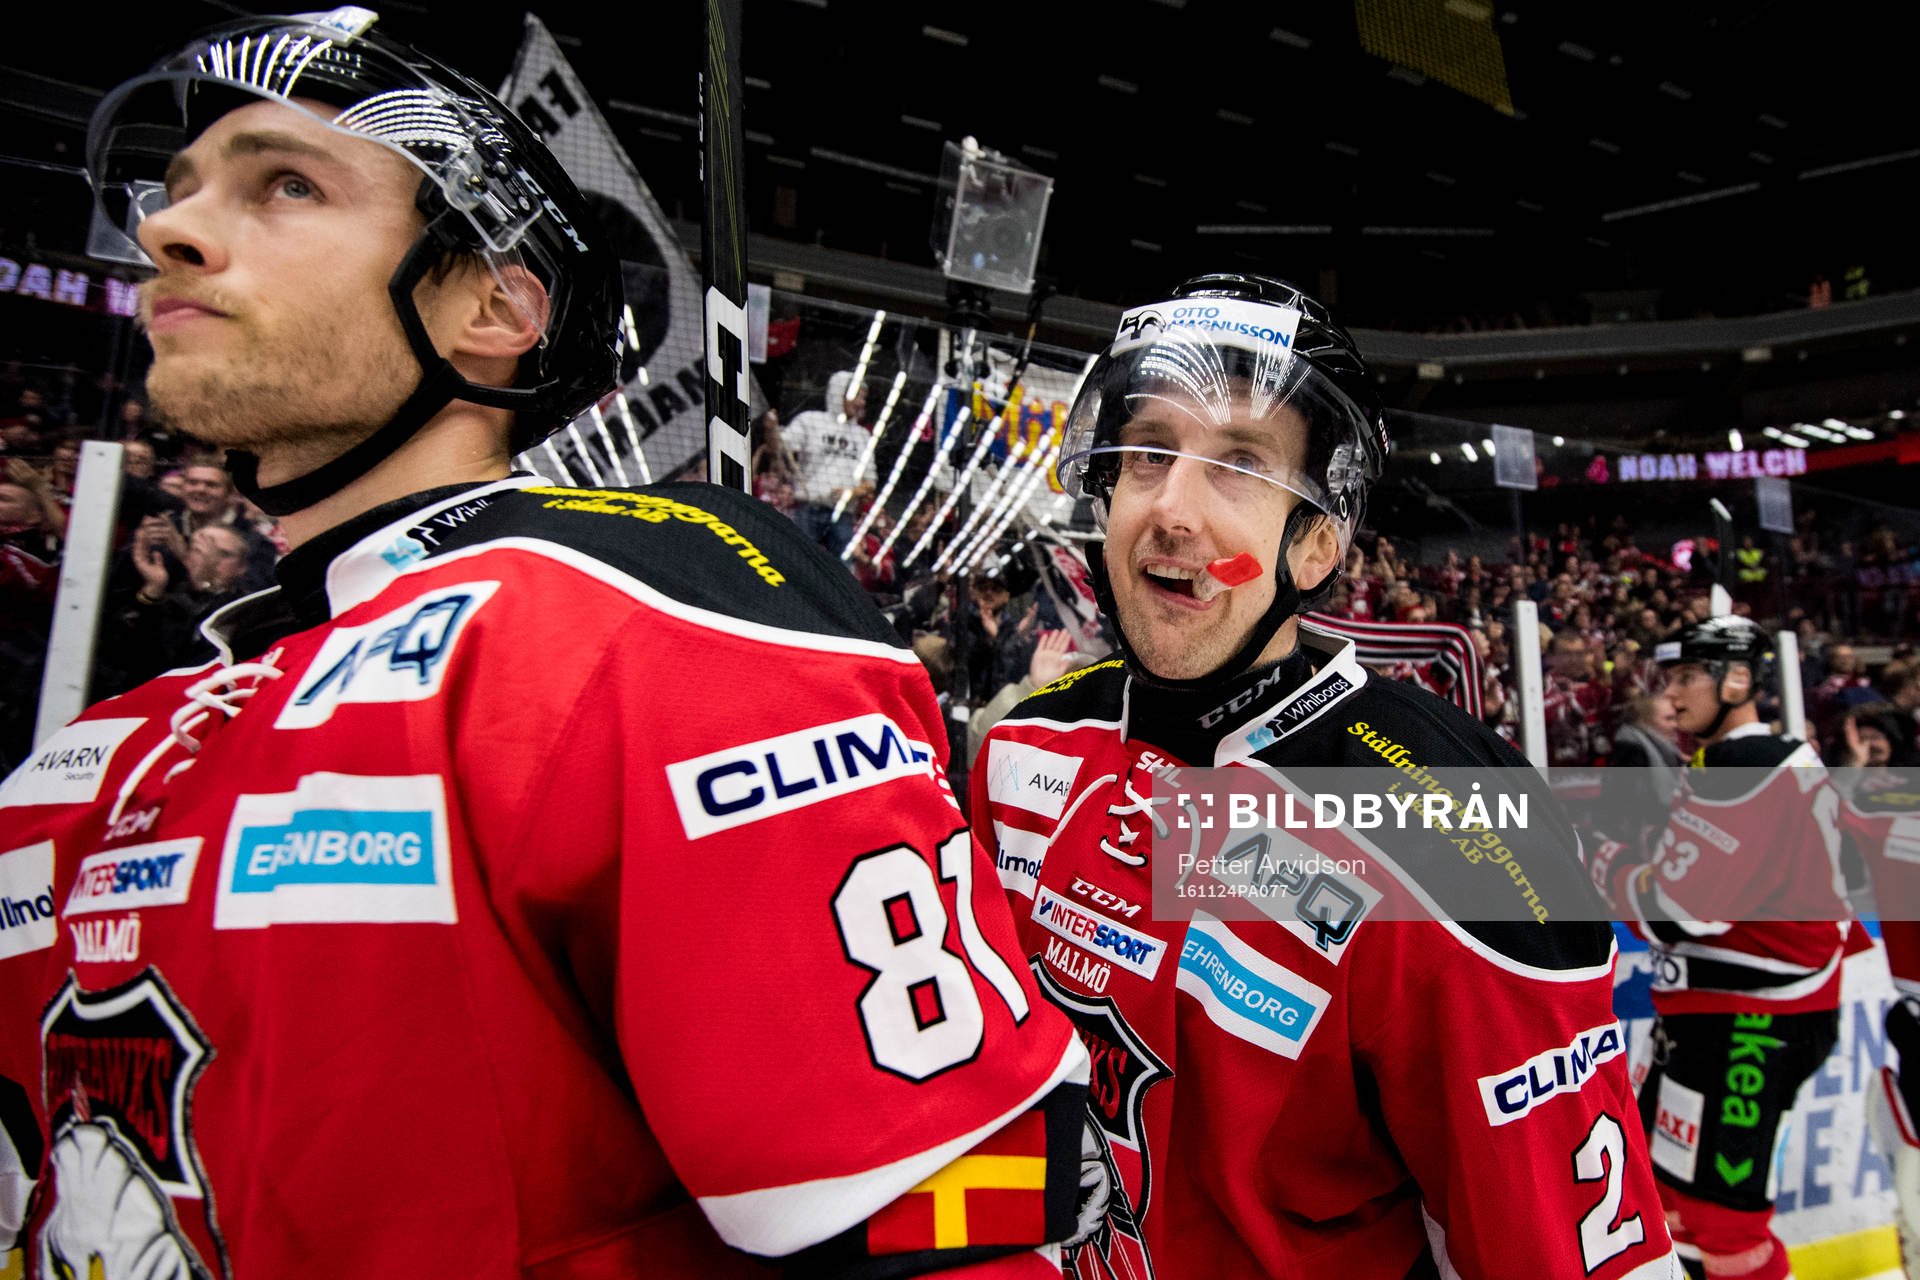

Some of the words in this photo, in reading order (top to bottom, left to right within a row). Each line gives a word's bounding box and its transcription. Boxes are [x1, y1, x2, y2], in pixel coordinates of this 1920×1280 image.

[1167, 319, 1291, 347] MAGNUSSON
[1173, 307, 1220, 319] OTTO
[1618, 453, 1697, 482] NOAH
[1704, 449, 1807, 480] WELCH
[1197, 666, 1282, 730] CCM
[1284, 678, 1349, 722] Wihlborgs
[31, 745, 110, 772] AVARN
[64, 771, 95, 781] Security
[1136, 750, 1182, 788] SHL
[1450, 837, 1484, 865] AB
[1071, 876, 1142, 918] CCM
[830, 826, 1031, 1085] 81
[1050, 902, 1157, 966] INTERSPORT
[1045, 936, 1112, 994] MALMÖ
[1180, 939, 1300, 1027] EHRENBORG
[1494, 1028, 1620, 1115] CLIMA
[1571, 1109, 1647, 1278] 2
